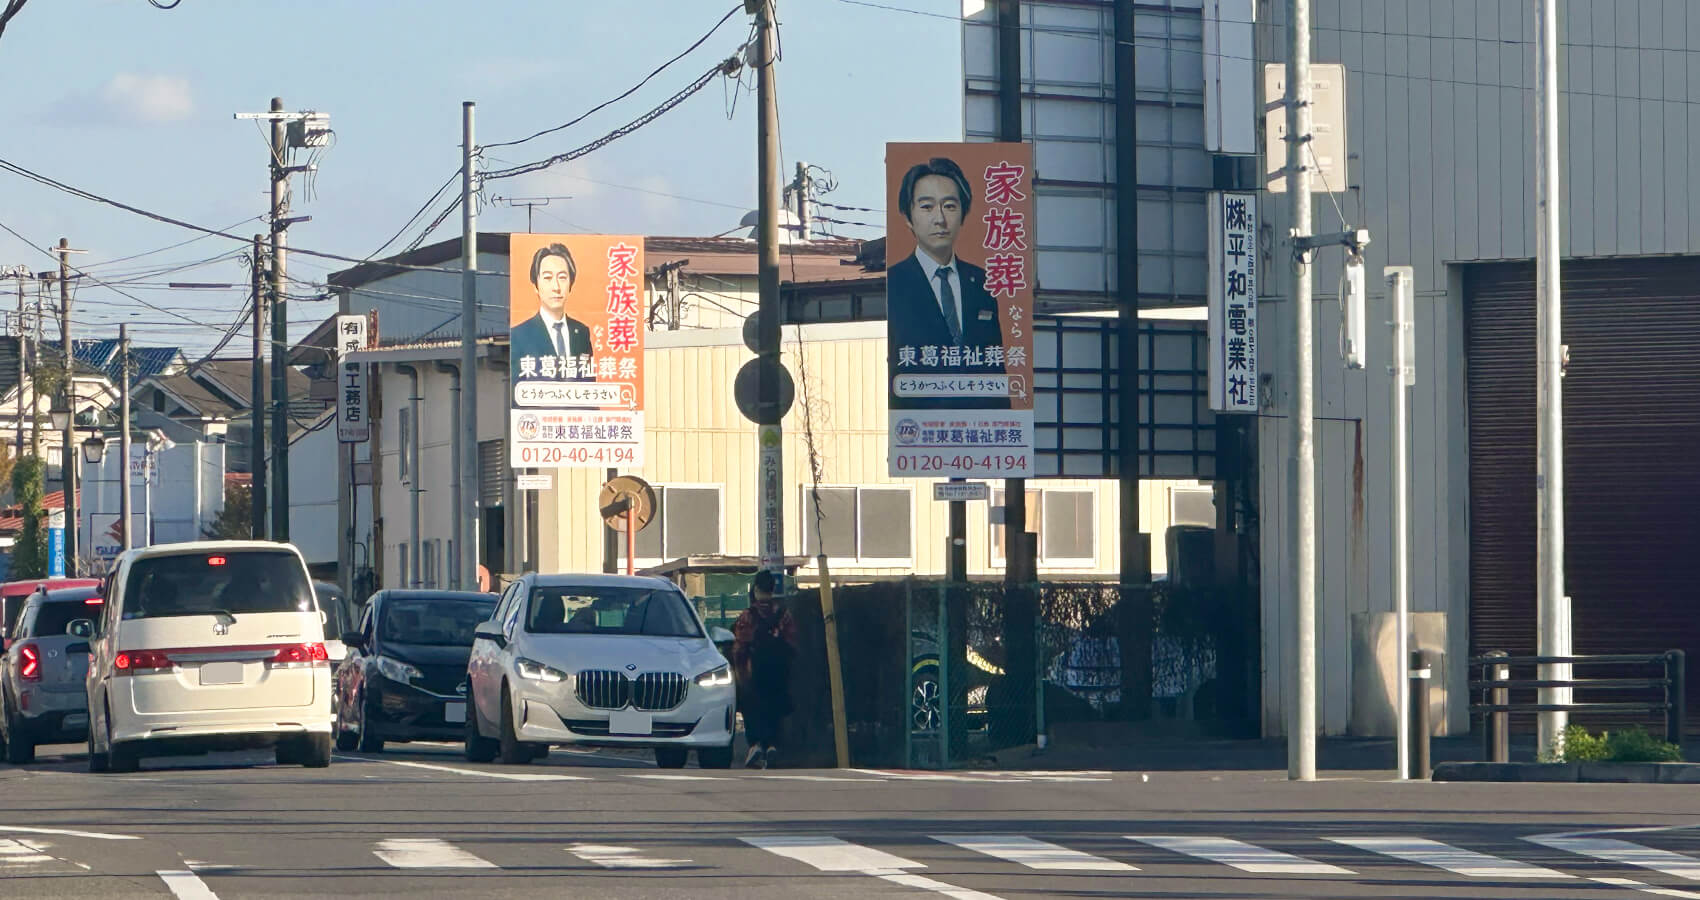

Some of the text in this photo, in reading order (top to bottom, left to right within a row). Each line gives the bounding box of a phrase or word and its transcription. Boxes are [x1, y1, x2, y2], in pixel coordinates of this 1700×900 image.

[983, 161, 1026, 298] 家族葬
[607, 242, 639, 353] 家族葬
[1008, 305, 1024, 339] なら
[593, 325, 604, 351] なら
[519, 355, 637, 379] 東葛福祉葬祭
[897, 345, 1027, 367] 東葛福祉葬祭
[340, 321, 363, 422] (有)成工務店
[521, 388, 618, 401] とうかつふくしそうさい
[899, 379, 1006, 392] とうかつふくしそうさい
[522, 447, 634, 463] 0120-40-4194
[897, 455, 1027, 471] 0120-40-4194
